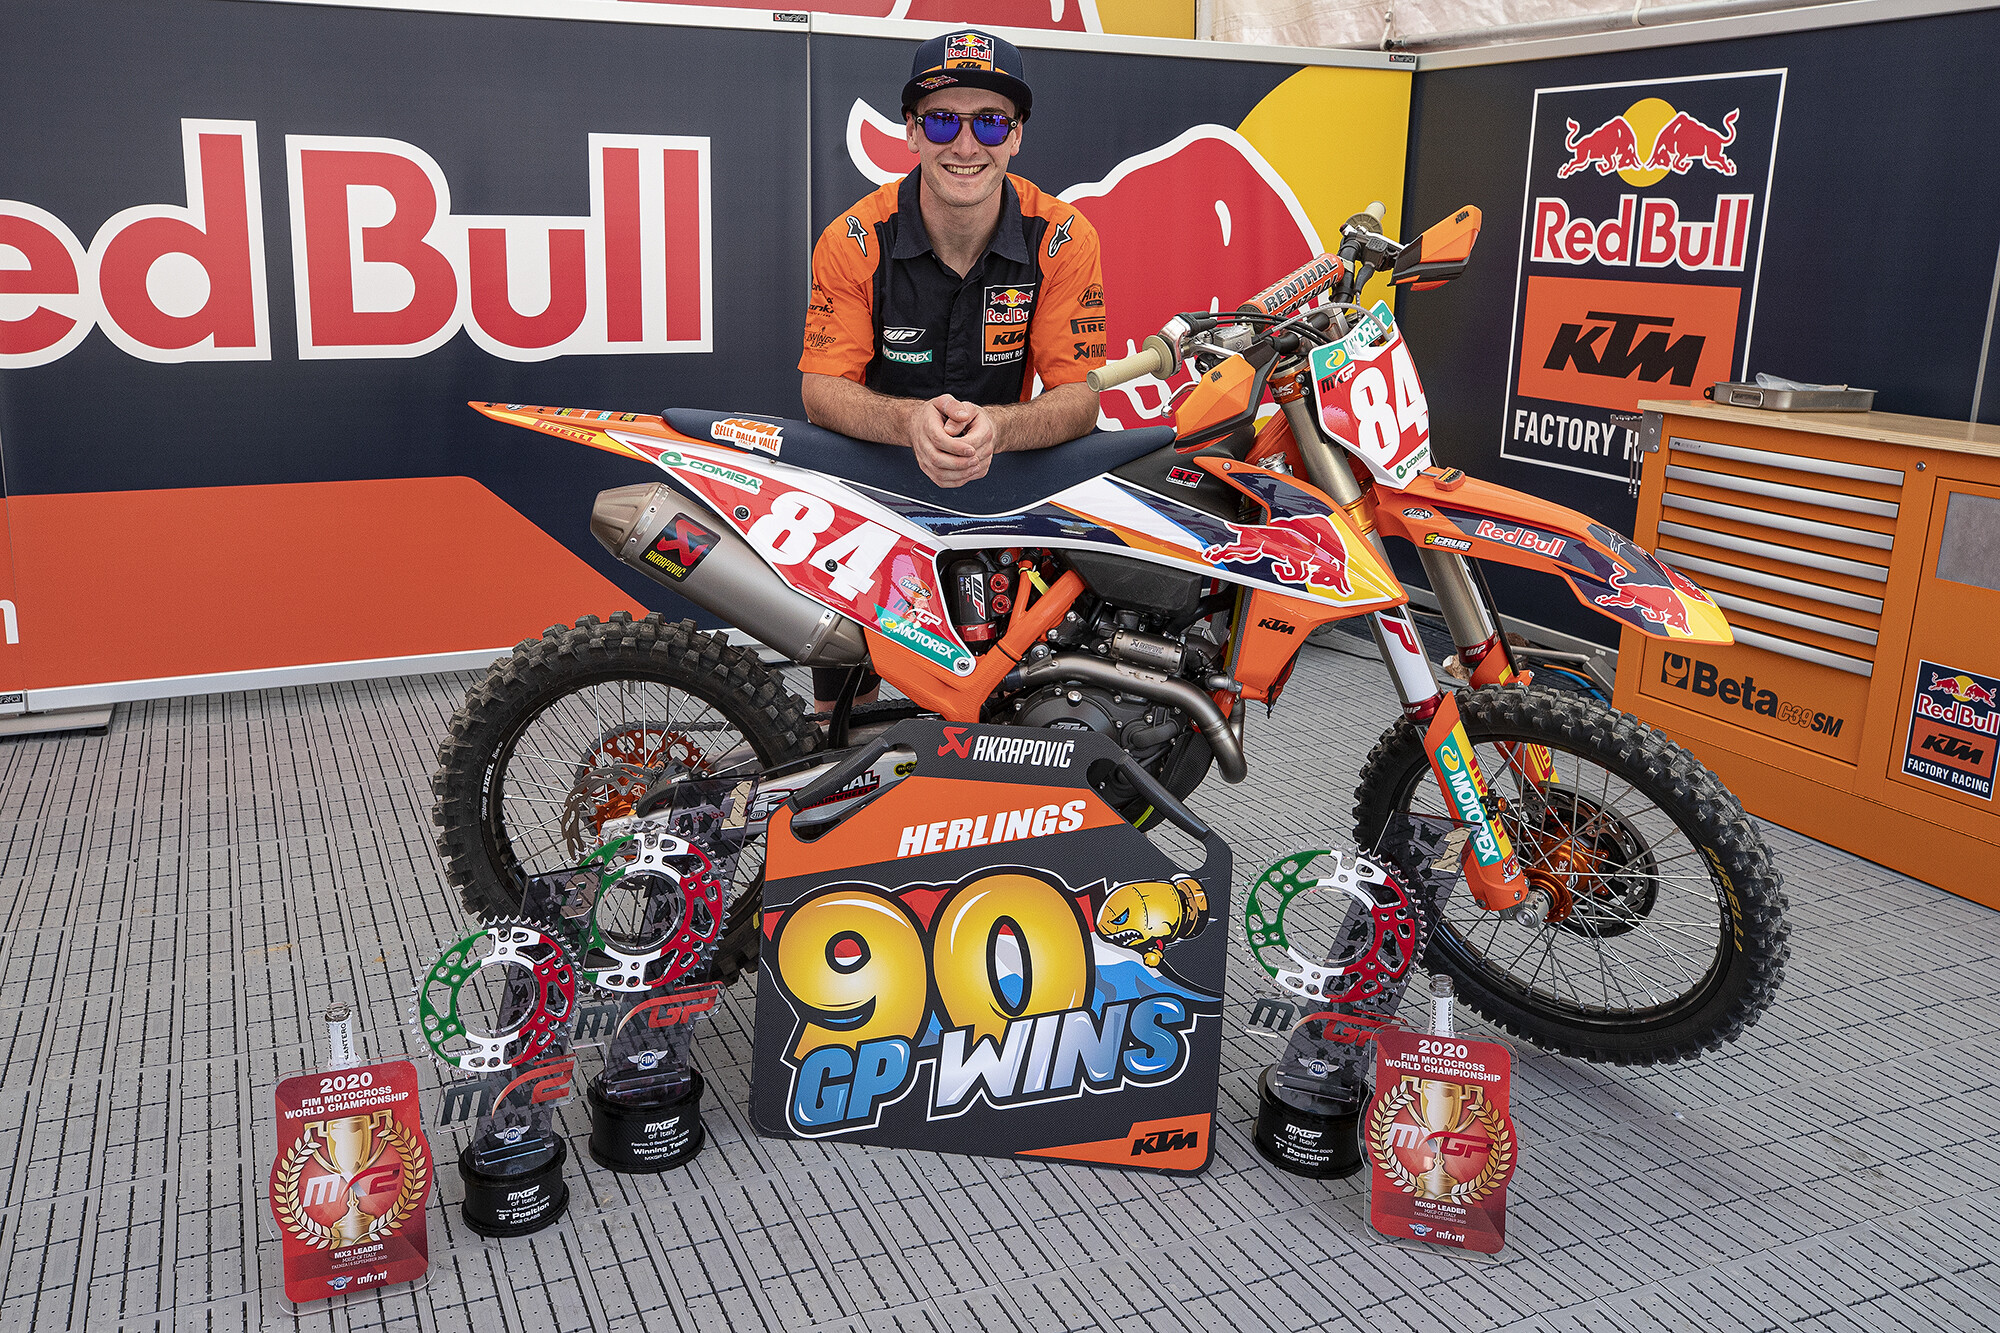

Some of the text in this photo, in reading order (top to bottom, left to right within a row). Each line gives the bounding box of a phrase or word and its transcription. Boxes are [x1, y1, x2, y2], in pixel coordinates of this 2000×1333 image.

[947, 47, 992, 60] Red Bull
[1533, 195, 1752, 271] Red Bull
[290, 139, 708, 356] Bull
[1263, 258, 1339, 313] RENTHAL
[986, 308, 1012, 323] Red
[883, 346, 931, 362] MOTOREX
[985, 353, 1014, 362] FACTORY
[1543, 311, 1706, 388] KTM
[1321, 362, 1357, 394] MXGP
[1349, 340, 1430, 459] 84
[532, 418, 598, 443] PIRELLI
[714, 423, 779, 452] SELLE DALLA VALLE
[724, 418, 779, 437] KTM
[1513, 409, 1616, 457] FACTORY
[1405, 446, 1429, 469] COMISA
[688, 459, 760, 491] COMISA
[1170, 468, 1202, 483] ETS
[747, 490, 902, 602] 84
[1476, 519, 1567, 558] Red Bull
[901, 578, 931, 598] Twin Air
[1258, 617, 1296, 636] KTM
[896, 622, 956, 660] MOTOREX
[1465, 644, 1486, 656] WP
[1691, 659, 1844, 738] Beta C39SM
[1916, 692, 2000, 736] Red Bull
[1920, 733, 1985, 766] KTM
[1907, 757, 1990, 794] FACTORY RACING
[896, 799, 1088, 859] HERLINGS
[778, 873, 1088, 1061] 90
[641, 1054, 656, 1064] FIM
[1418, 1039, 1469, 1060] 2020
[793, 1000, 1187, 1128] GP WINS
[1311, 1063, 1326, 1073] FIM
[1384, 1058, 1502, 1083] WORLD CHAMPIONSHIP
[1400, 1052, 1486, 1073] FIM MOTOCROSS
[319, 1071, 374, 1094] 2020
[284, 1091, 410, 1120] WORLD CHAMPIONSHIP
[301, 1085, 393, 1108] FIM MOTOCROSS
[643, 1116, 680, 1133] MXGP
[647, 1128, 677, 1140] of Italy
[1285, 1123, 1323, 1140] MXGP
[633, 1137, 689, 1155] Winning Team
[1130, 1127, 1198, 1157] KTM
[1299, 1137, 1318, 1148] Italy
[1286, 1147, 1330, 1162] Position
[302, 1161, 401, 1208] MX2
[506, 1184, 540, 1202] MXGP
[512, 1201, 550, 1220] Position
[521, 1195, 538, 1205] Italy
[1414, 1200, 1467, 1215] MXGP LEADER
[334, 1243, 384, 1259] MX2 LEADER
